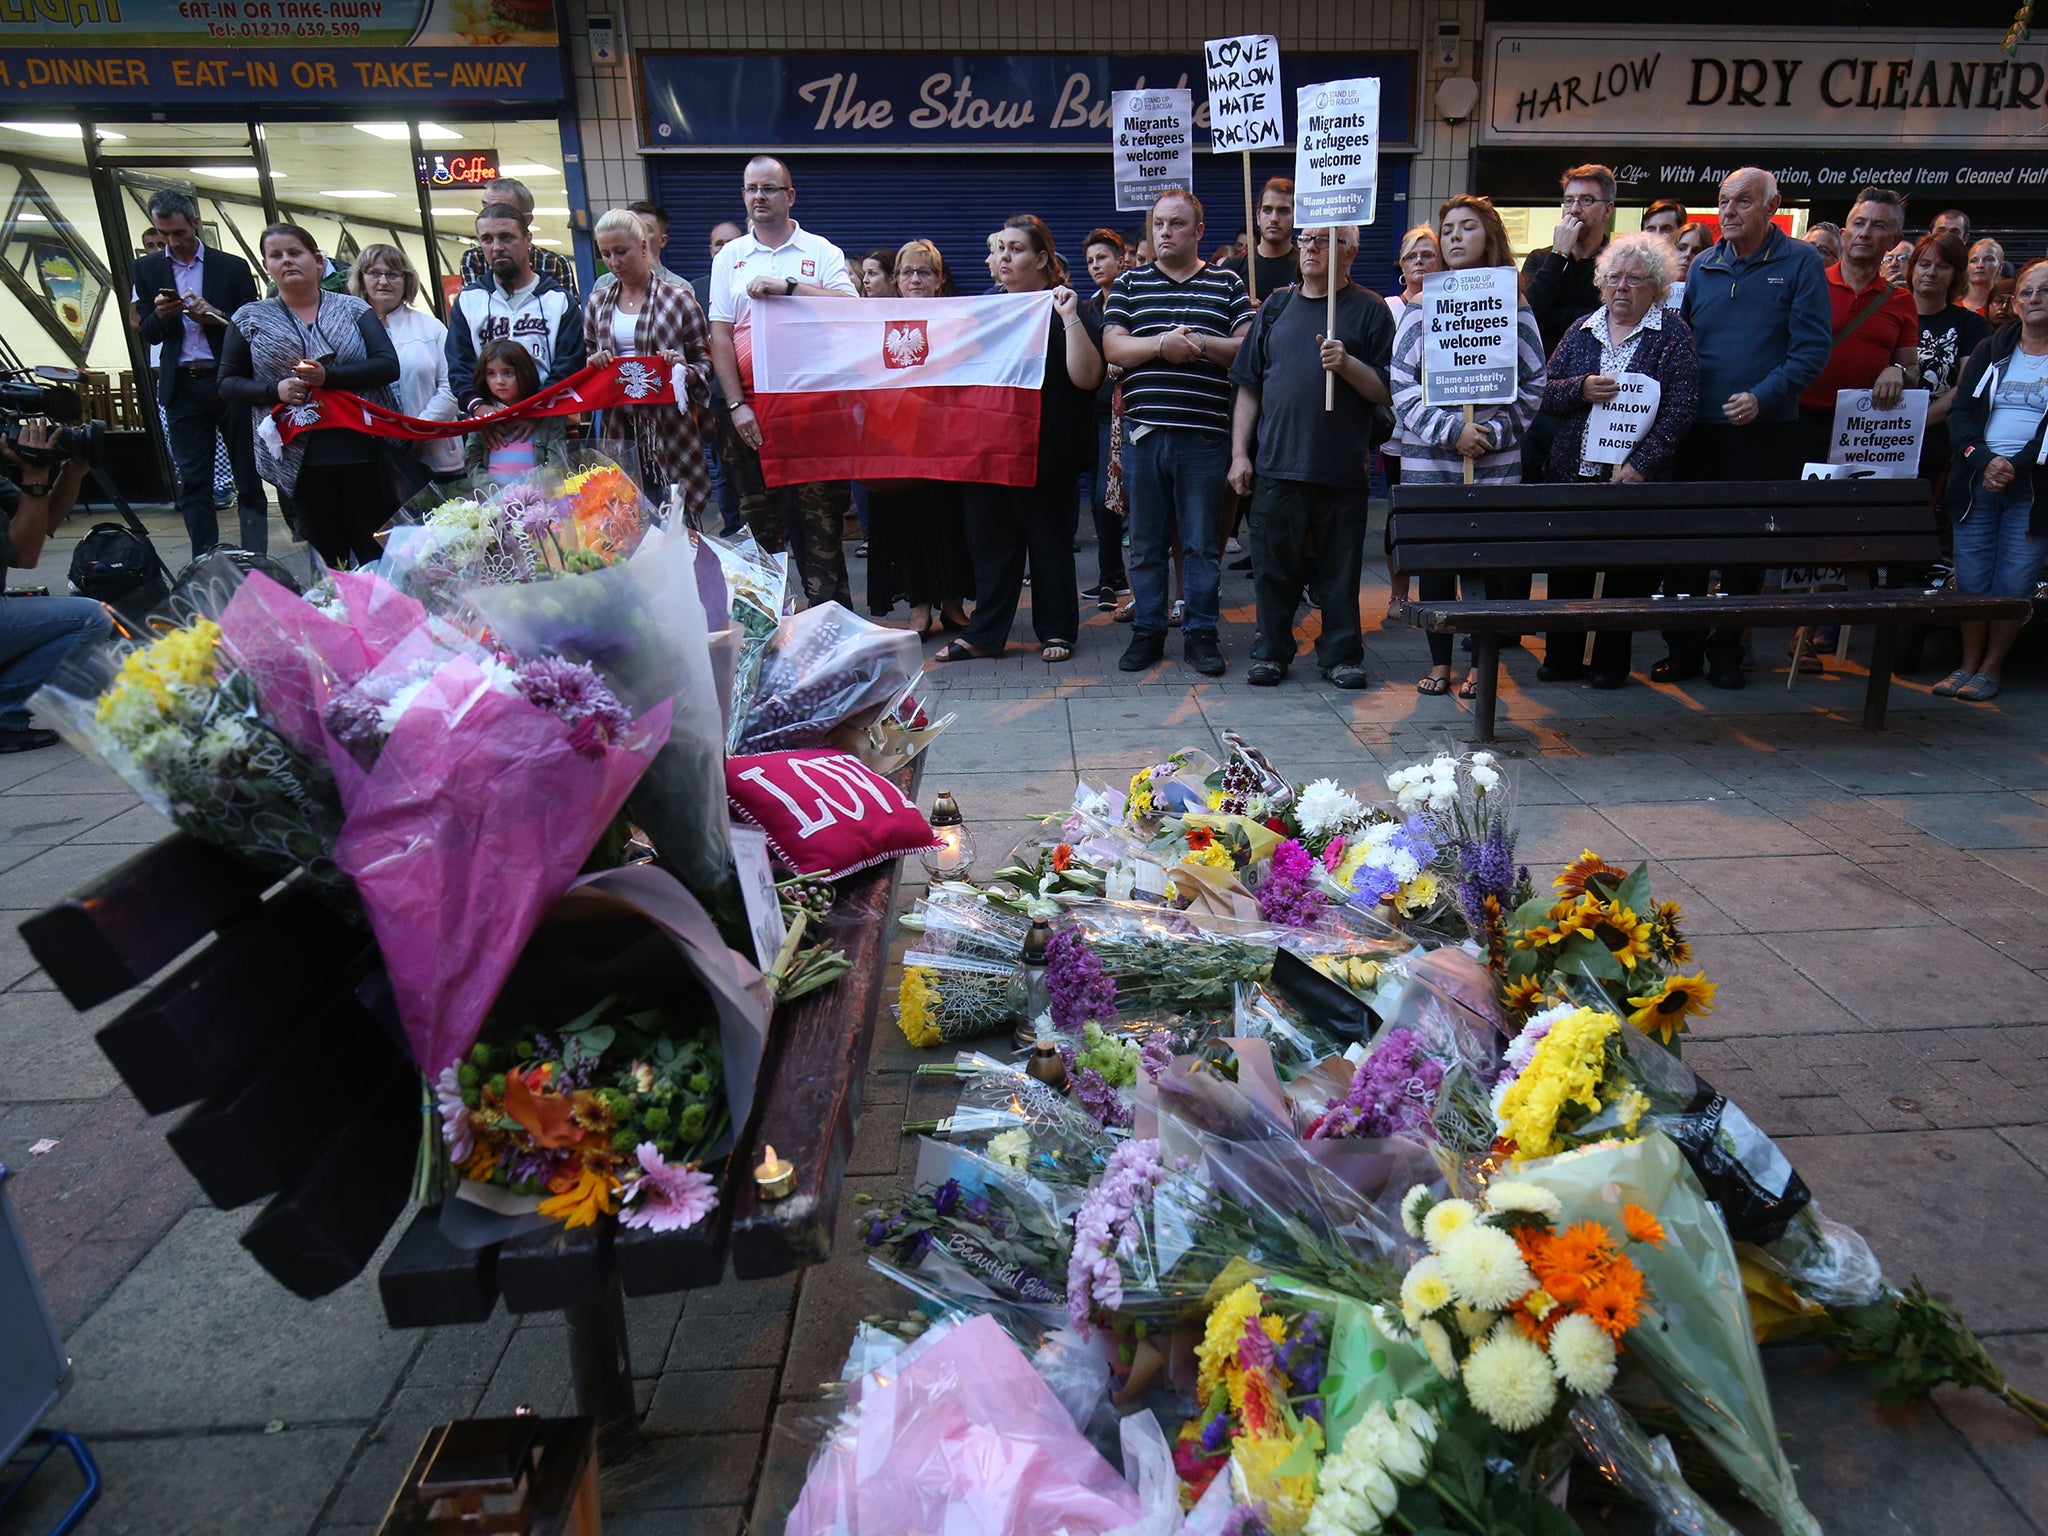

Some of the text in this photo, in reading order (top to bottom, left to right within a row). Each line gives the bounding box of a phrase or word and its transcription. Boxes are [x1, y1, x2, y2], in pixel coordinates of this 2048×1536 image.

[179, 2, 382, 18] EAT-IN OR TAKE-AWAY
[207, 22, 360, 38] Tel: 01279 639 599
[1512, 42, 1521, 53] 14
[172, 60, 279, 88] EAT-IN
[291, 61, 338, 88] OR
[353, 61, 527, 88] TAKE-AWAY
[1209, 64, 1274, 93] HARLOW
[1516, 53, 2048, 123] HARLOW DRY CLEANER
[799, 72, 893, 130] The
[909, 72, 1034, 129] Stow
[1220, 93, 1266, 116] HATE
[1336, 97, 1360, 105] RACISM
[1124, 116, 1179, 133] Migrants
[1309, 113, 1365, 133] Migrants
[1120, 133, 1184, 148] & refugees
[1303, 133, 1369, 151] & refugees
[1127, 149, 1179, 162] welcome
[1310, 153, 1361, 169] welcome
[450, 156, 496, 184] Coffee
[1140, 165, 1167, 177] here
[1620, 164, 1651, 181] Offer
[1660, 165, 1695, 183] With
[1699, 165, 1730, 187] Any
[1817, 167, 1847, 184] One
[1850, 167, 1914, 184] Selected
[1915, 167, 1949, 184] Item
[1955, 167, 2014, 184] Cleaned
[1320, 172, 1346, 187] here
[1131, 193, 1143, 201] not
[1303, 192, 1364, 206] Blame austerity,
[1310, 205, 1356, 217] not migrants
[1460, 276, 1480, 284] STAND
[1470, 282, 1495, 290] RACISM
[1436, 296, 1502, 316] Migrants
[1431, 316, 1508, 333] & refugees
[1439, 334, 1502, 350] welcome
[1454, 352, 1487, 366] here
[1436, 372, 1506, 385] Blame austerity,
[1444, 383, 1499, 394] not migrants
[1602, 402, 1651, 414] HARLOW
[1609, 422, 1637, 433] HATE
[1847, 417, 1911, 433] Migrants
[1839, 433, 1914, 449] & refugees
[1845, 449, 1905, 462] welcome
[738, 755, 916, 840] LOV
[946, 1233, 1024, 1290] Beautiful
